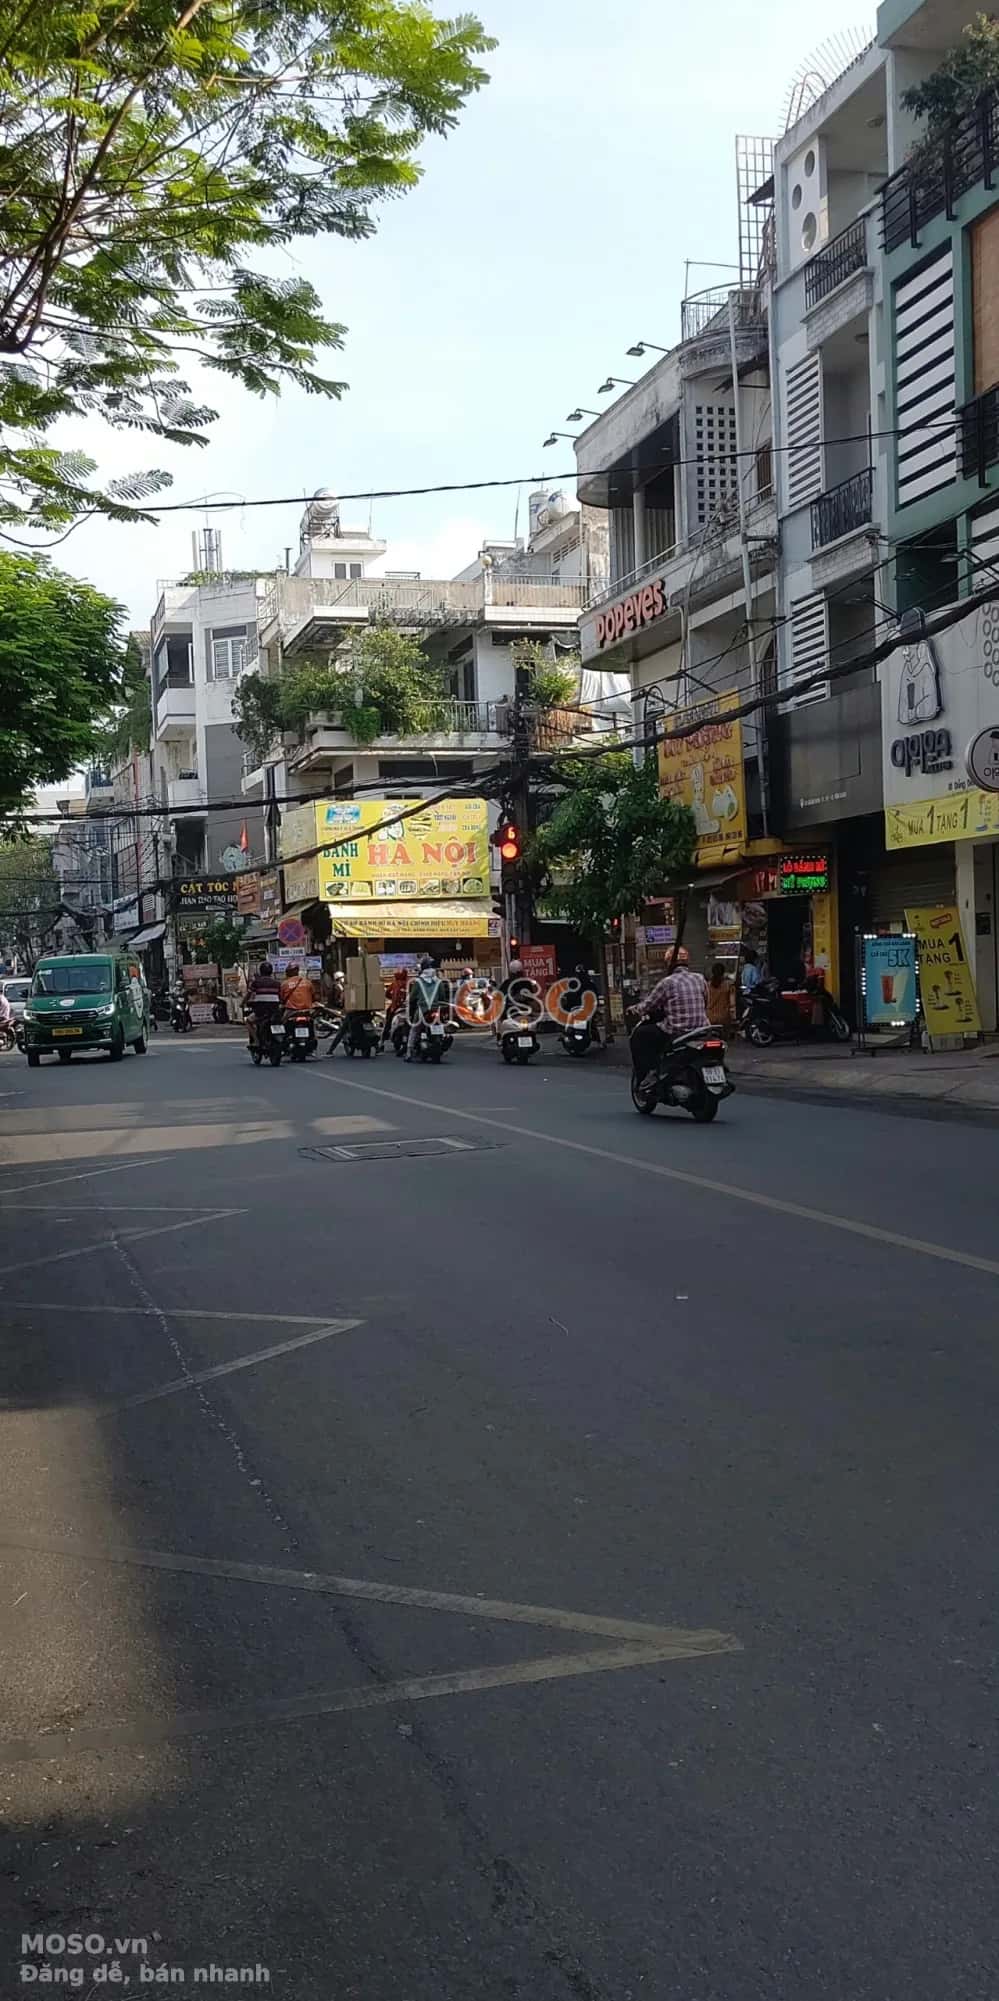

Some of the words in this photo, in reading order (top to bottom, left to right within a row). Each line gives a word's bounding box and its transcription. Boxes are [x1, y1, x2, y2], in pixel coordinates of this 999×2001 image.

[908, 818, 924, 836] MUA
[926, 804, 935, 835] 1
[960, 797, 969, 830] 1
[508, 827, 515, 839] 6
[367, 838, 413, 866] HÀ
[421, 836, 477, 868] NỘI
[888, 948, 911, 967] 5K
[919, 938, 945, 950] MUA
[948, 932, 964, 962] 1
[523, 958, 545, 967] MUA
[545, 957, 554, 976] 1
